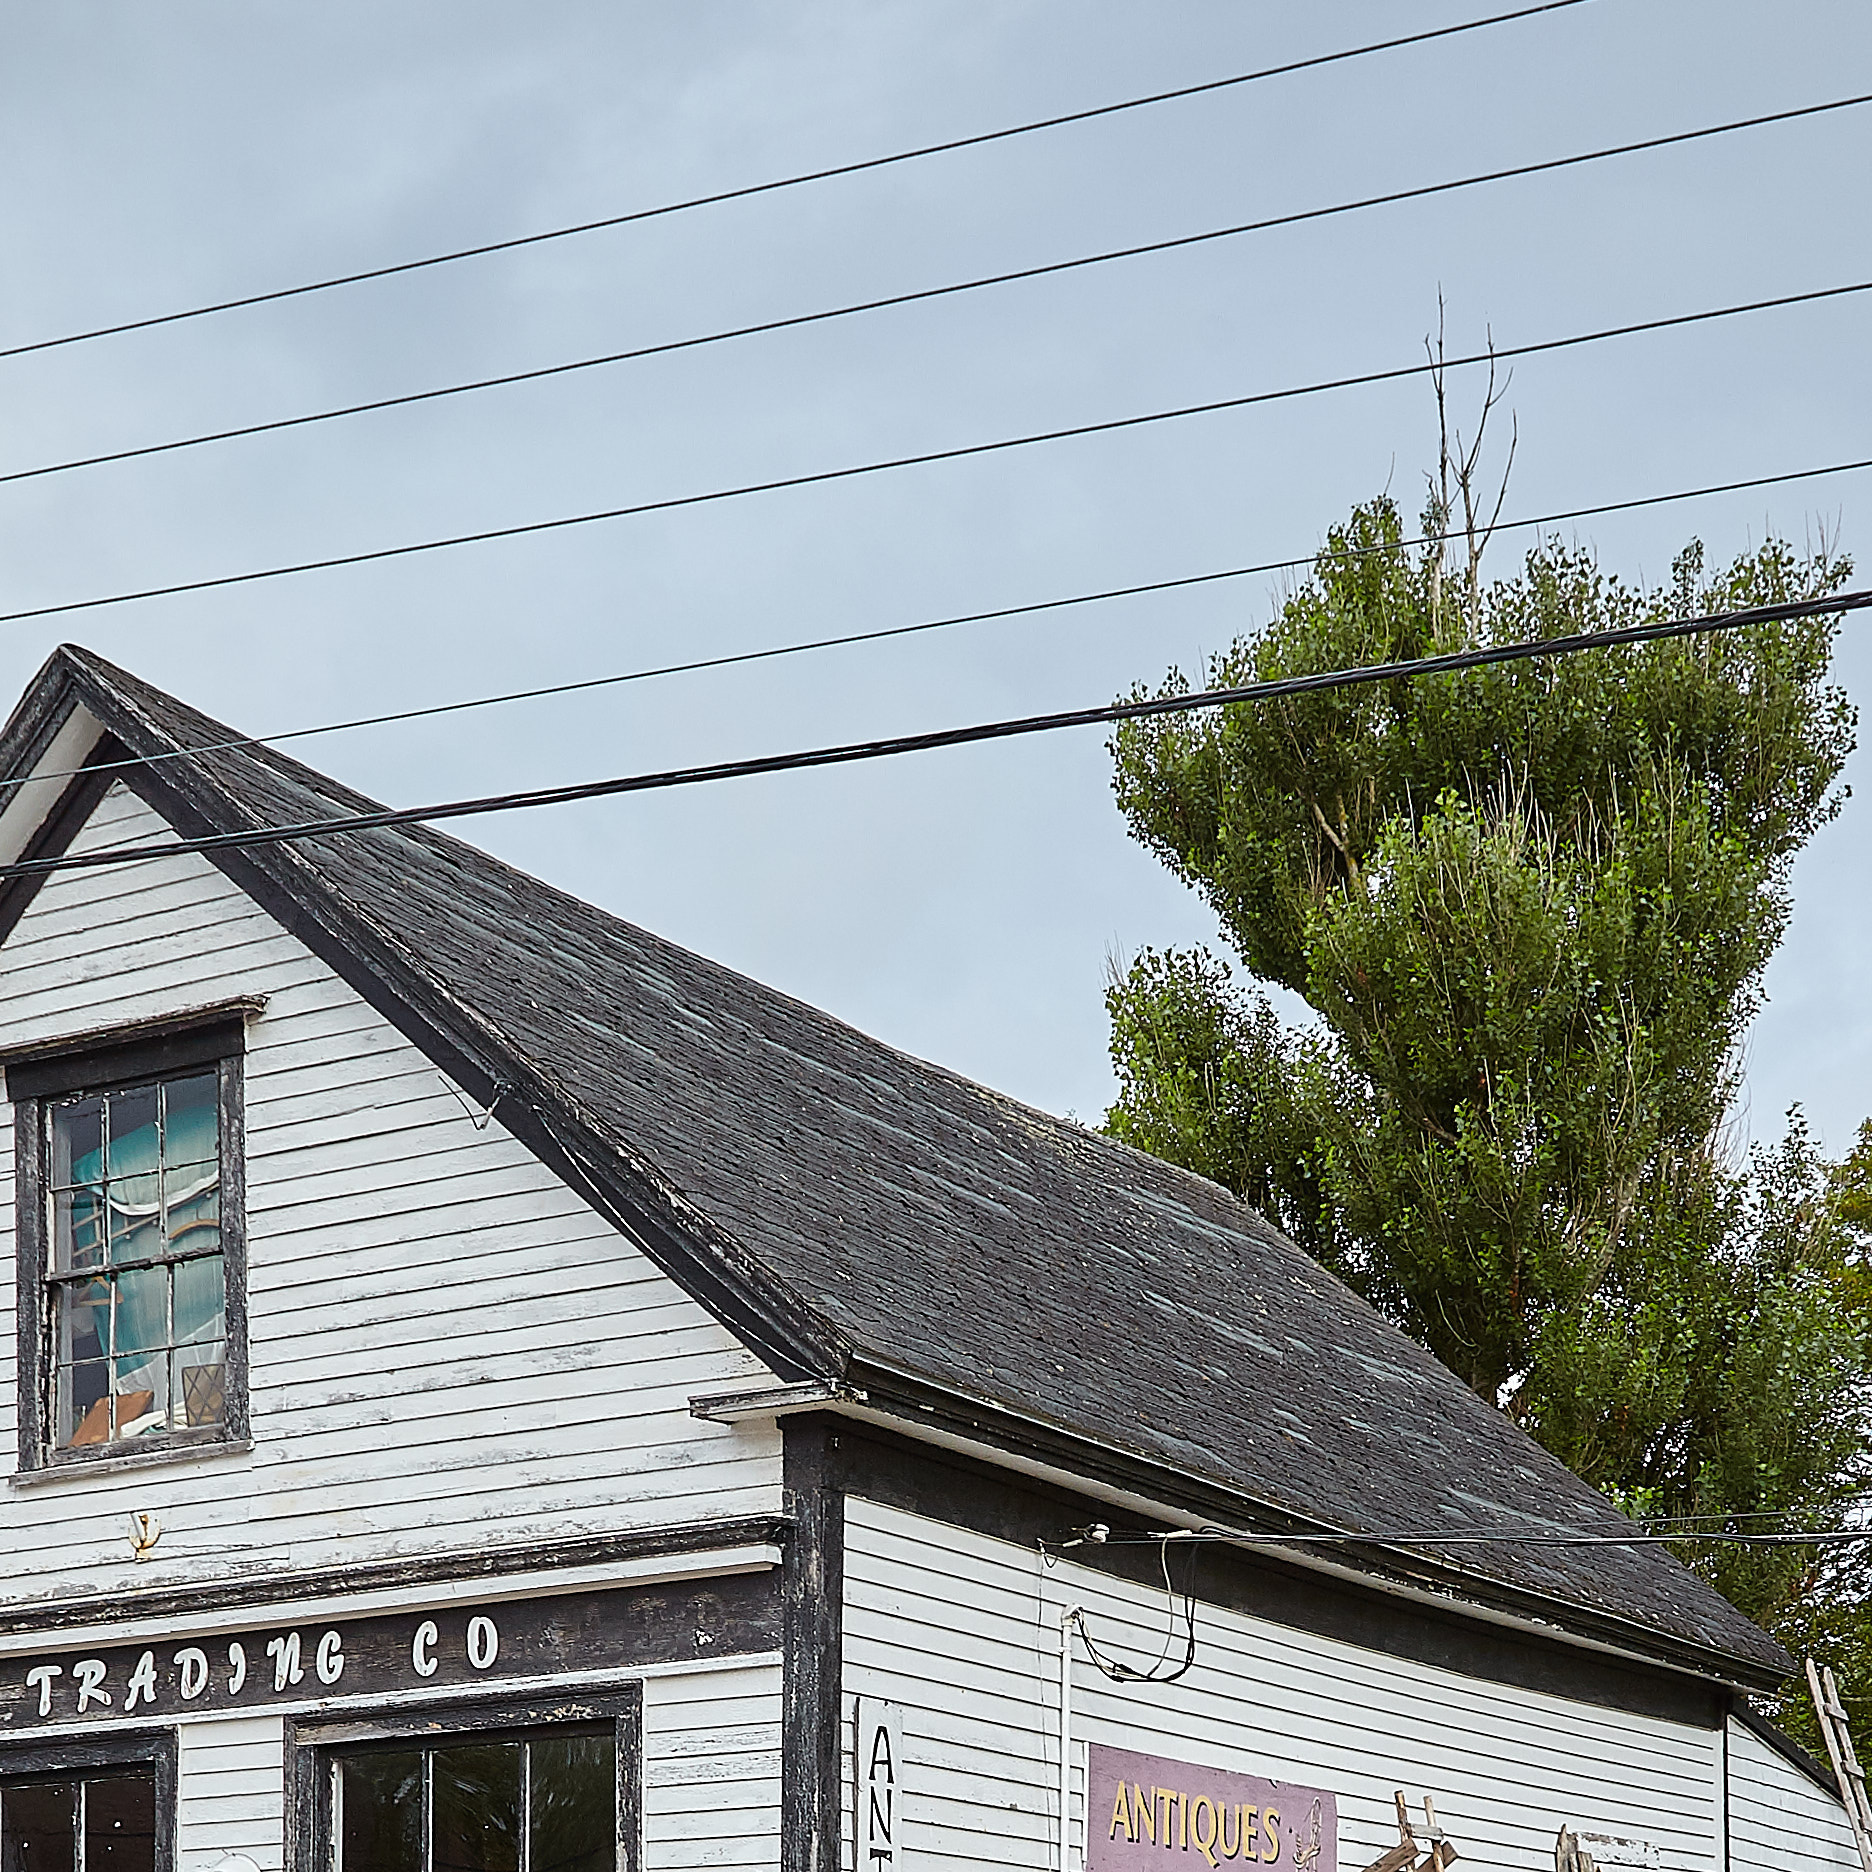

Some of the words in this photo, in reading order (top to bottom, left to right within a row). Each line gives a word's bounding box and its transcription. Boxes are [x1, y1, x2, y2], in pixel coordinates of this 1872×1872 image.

[26, 1631, 345, 1717] TRADING
[412, 1616, 499, 1677] CO
[1109, 1780, 1281, 1869] ANTIQUES
